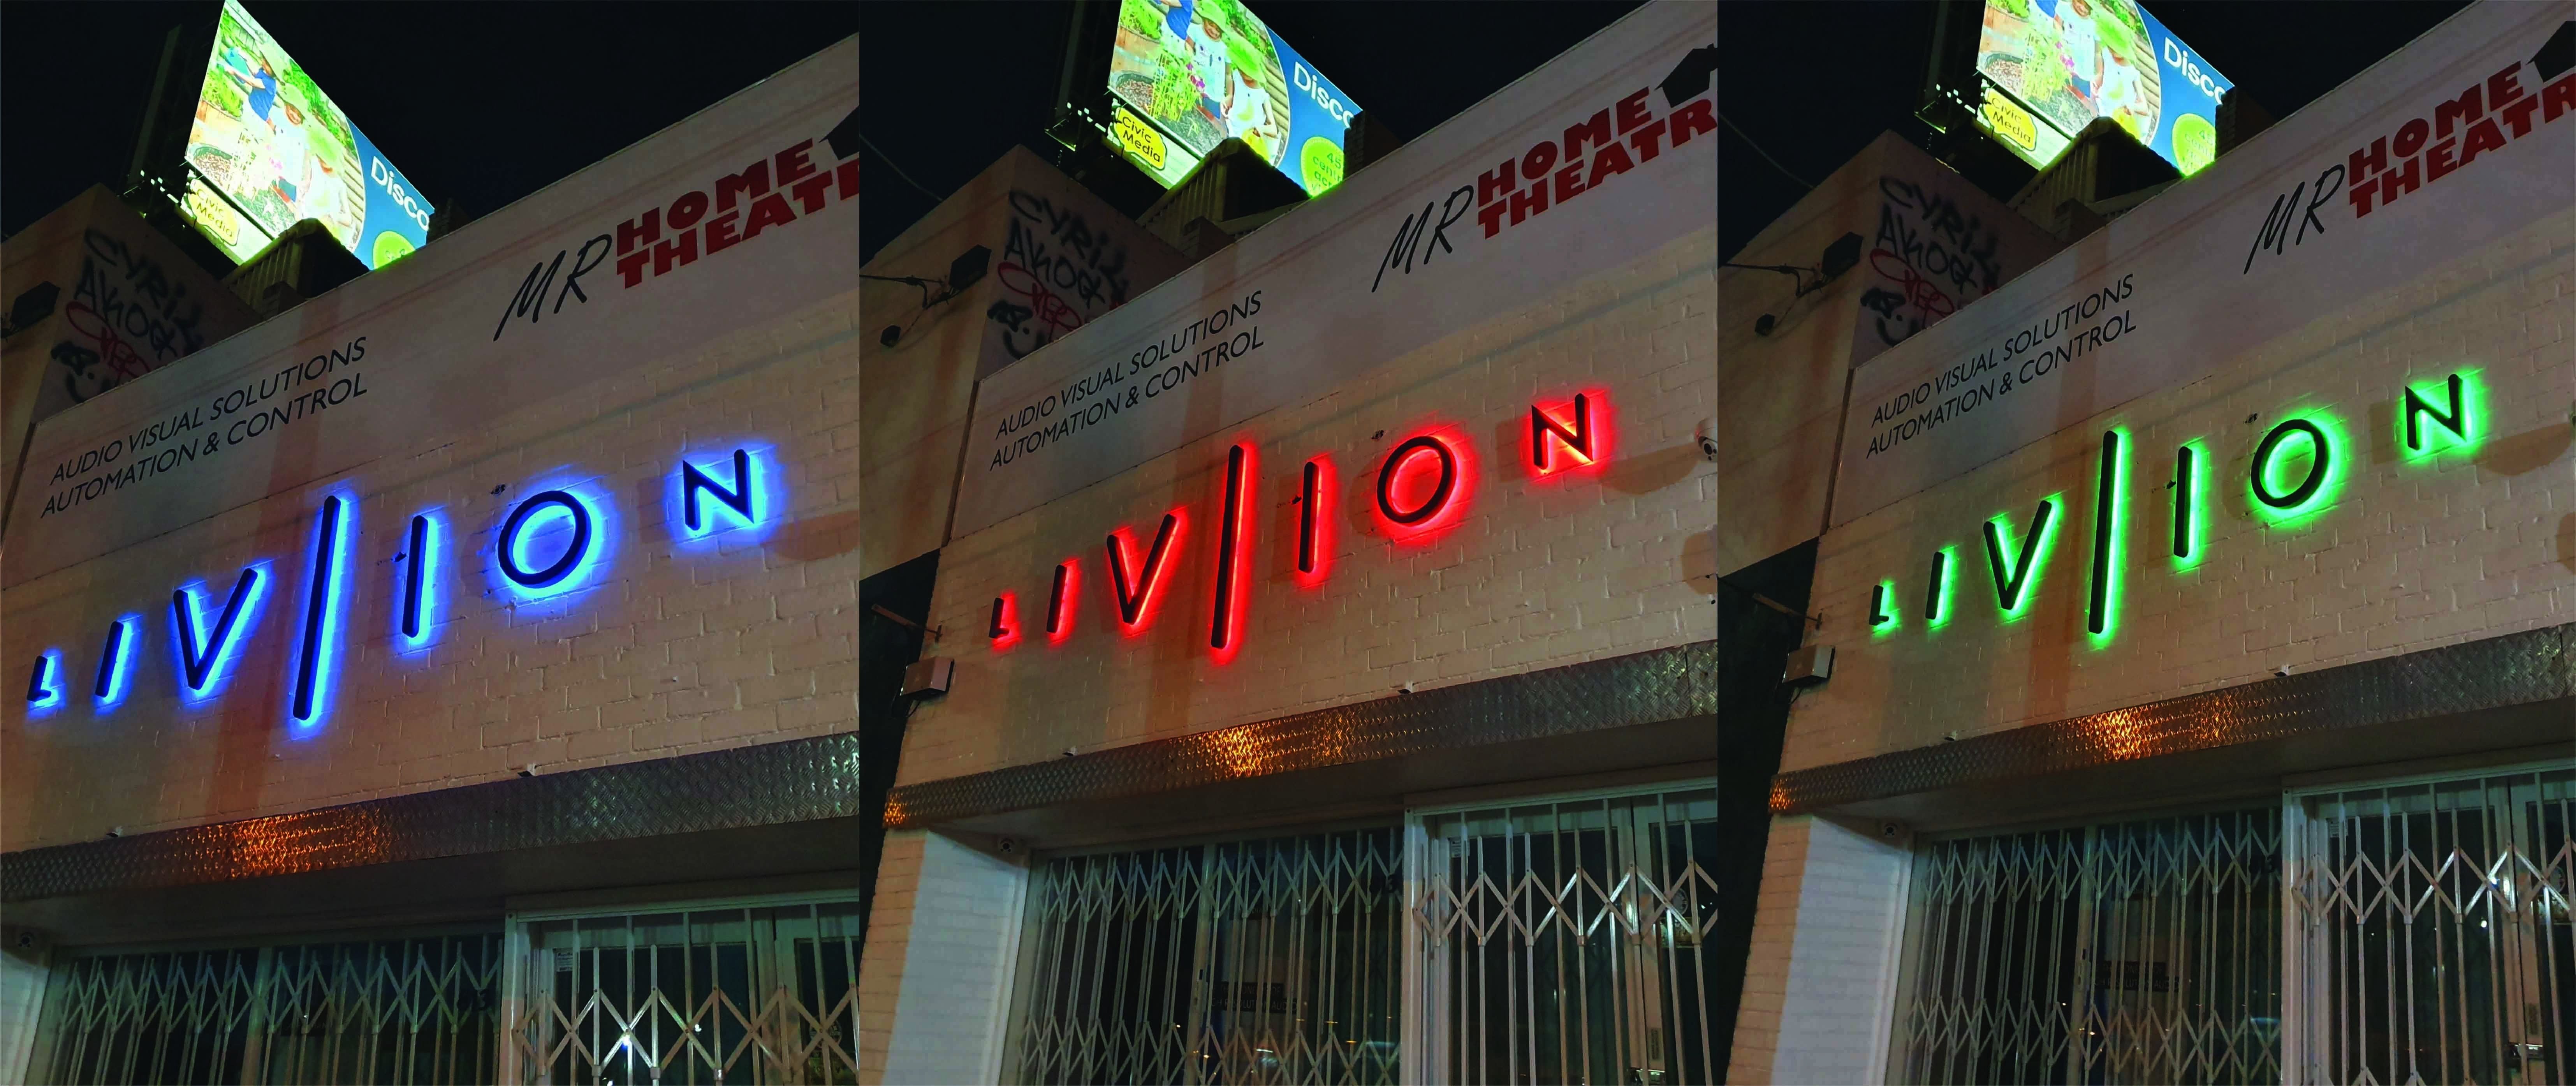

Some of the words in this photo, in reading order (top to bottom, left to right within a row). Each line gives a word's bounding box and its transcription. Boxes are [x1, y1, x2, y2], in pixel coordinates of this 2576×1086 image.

[1123, 116, 1152, 143] Civic
[1123, 130, 1161, 162] Media
[1327, 152, 1341, 169] 45
[1478, 86, 1652, 207] HOME
[1992, 97, 2022, 124] Civic
[1993, 111, 2031, 143] Media
[2349, 61, 2523, 186] HOME
[196, 202, 233, 237] Media
[197, 189, 224, 217] Civic
[616, 138, 816, 256] HOME
[1478, 99, 1717, 240] THEATR
[2243, 164, 2345, 275] MR
[493, 234, 612, 341] MR
[1371, 185, 1474, 293] MR
[989, 393, 1121, 471] AUTOMATION
[1125, 386, 1139, 409] &
[1145, 326, 1264, 398] CONTROL
[996, 395, 1056, 440] AUDIO
[1061, 363, 1124, 407] VISUAL
[1130, 290, 1262, 376] SOLUTIONS
[1866, 379, 1995, 459] AUTOMATION
[1999, 372, 2013, 395] &
[2019, 310, 2136, 385] CONTROL
[1871, 382, 1930, 428] AUDIO
[1935, 348, 1998, 394] VISUAL
[2003, 274, 2134, 361] SOLUTIONS
[40, 439, 201, 518] AUTOMATION
[203, 432, 220, 457] &
[228, 372, 368, 446] CONTROL
[49, 439, 122, 485] AUDIO
[129, 407, 203, 455] VISUAL
[209, 336, 367, 421] SOLUTIONS
